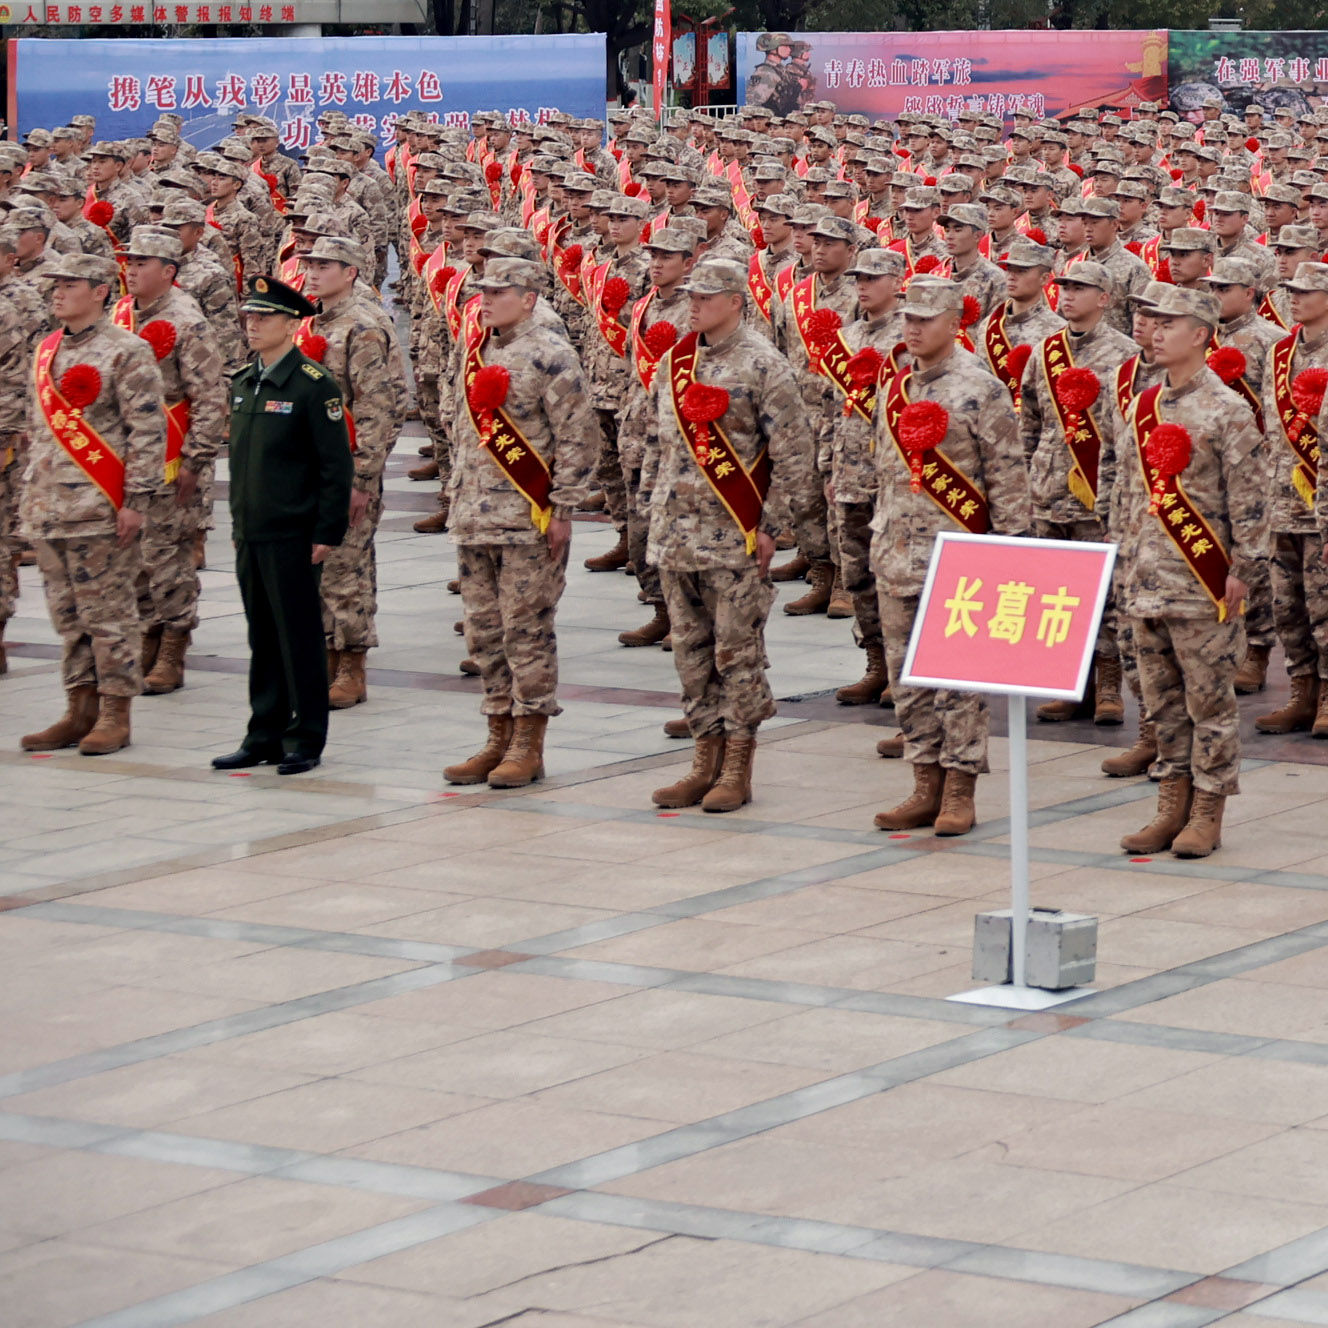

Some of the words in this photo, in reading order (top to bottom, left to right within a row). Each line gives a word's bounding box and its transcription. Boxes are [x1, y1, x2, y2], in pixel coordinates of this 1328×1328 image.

[23, 5, 296, 22] 人民防空多媒体警报报知终端
[108, 69, 443, 111] 携笔从戎彰显英雄本色
[824, 57, 971, 88] 青春热血踏军旅
[943, 576, 1081, 648] 长葛市
